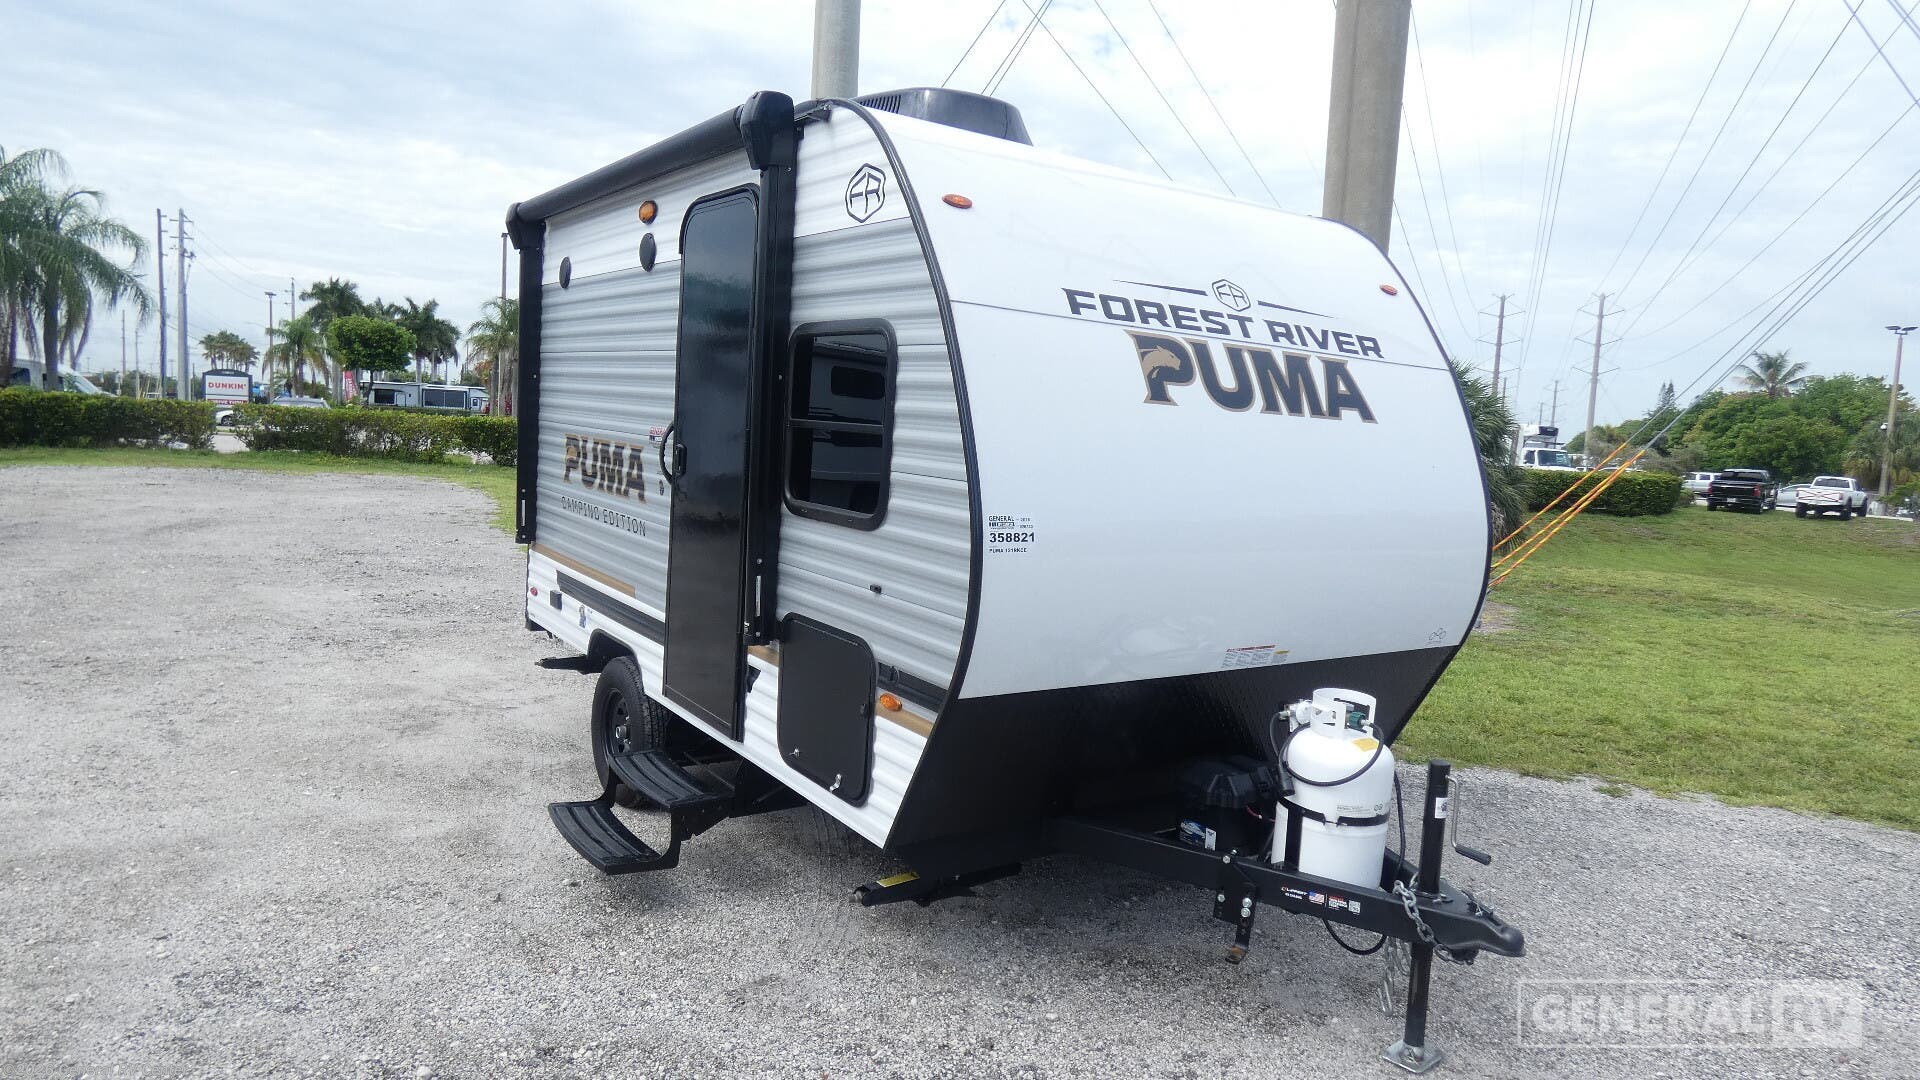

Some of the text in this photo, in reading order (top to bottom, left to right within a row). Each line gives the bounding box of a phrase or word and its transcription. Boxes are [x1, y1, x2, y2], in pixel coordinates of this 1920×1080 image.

[1061, 287, 1385, 359] FOREST RIVER
[1123, 329, 1379, 425] PUMA
[563, 433, 647, 504] PUMA
[561, 496, 646, 537] CAMPING EDITION
[989, 532, 1035, 543] 358821
